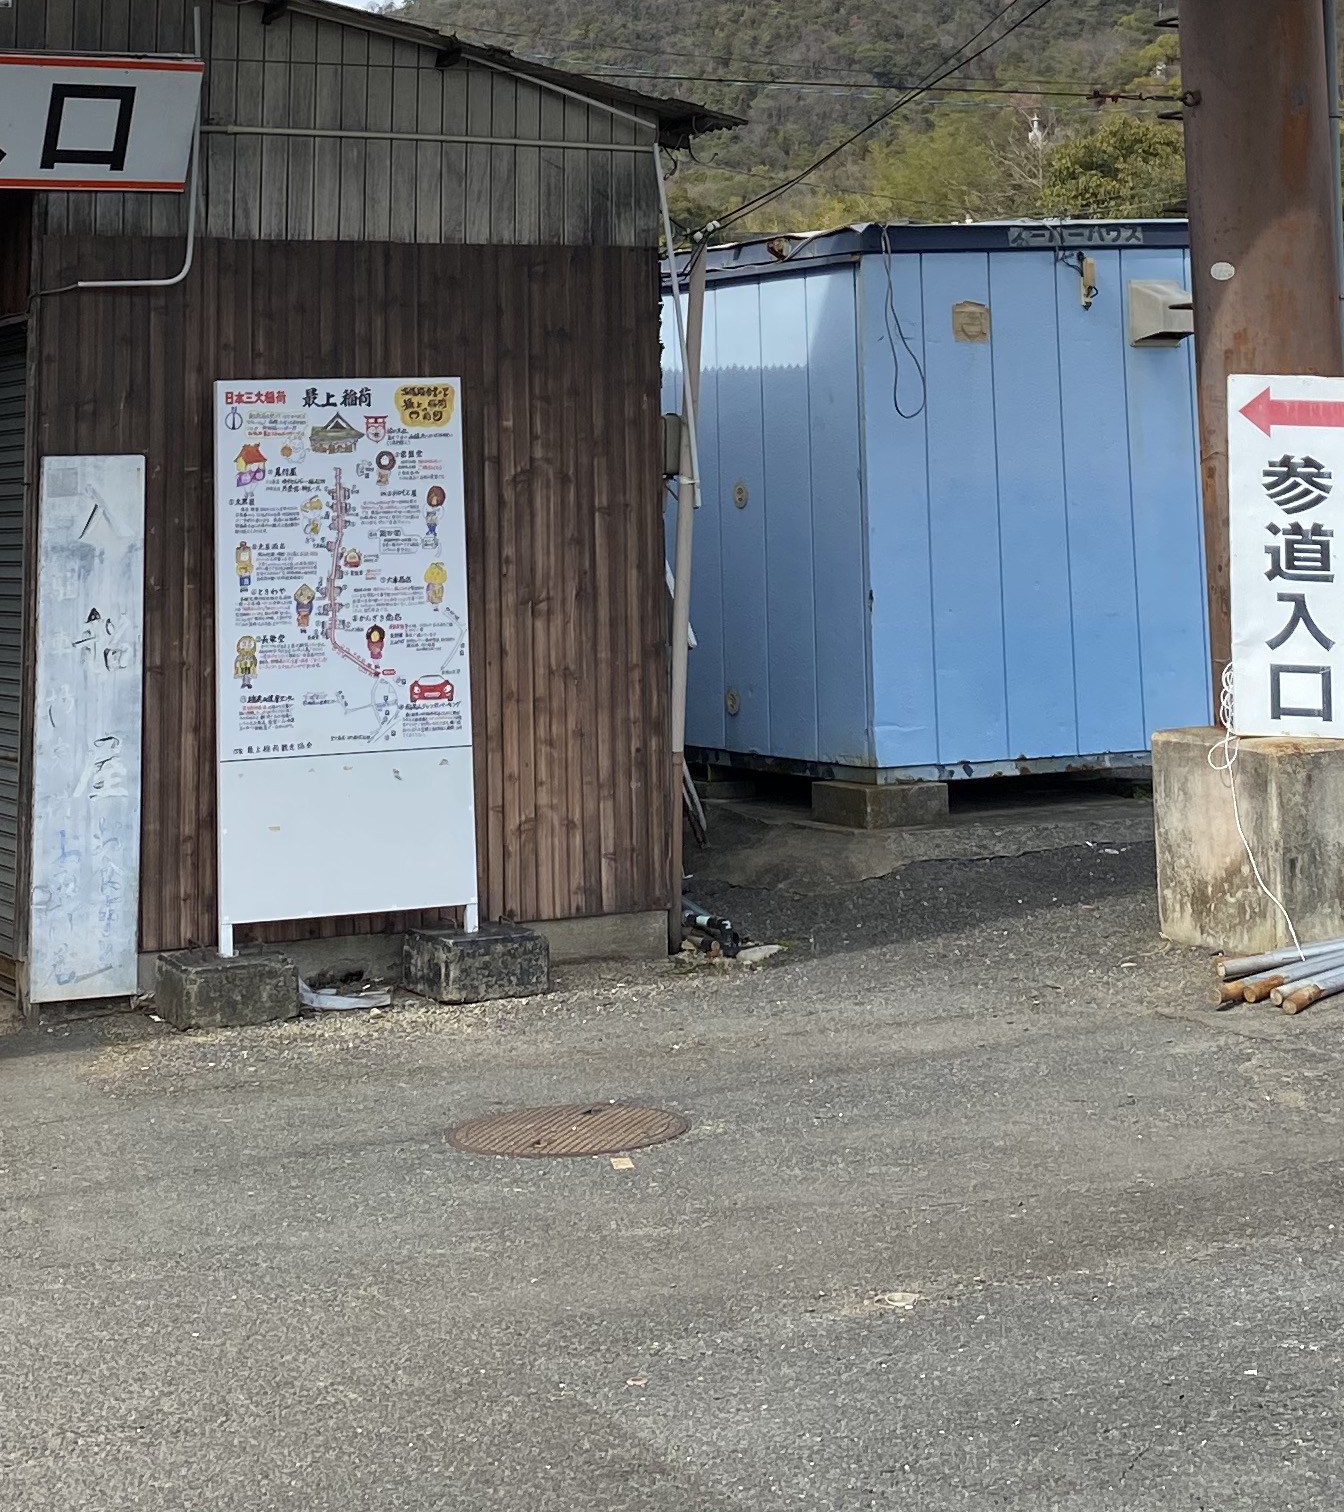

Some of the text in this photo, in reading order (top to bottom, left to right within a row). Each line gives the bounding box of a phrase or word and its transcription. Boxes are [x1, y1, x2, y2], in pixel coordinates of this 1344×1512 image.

[303, 387, 372, 407] 最上稲荷
[1262, 455, 1336, 722] 参道入口
